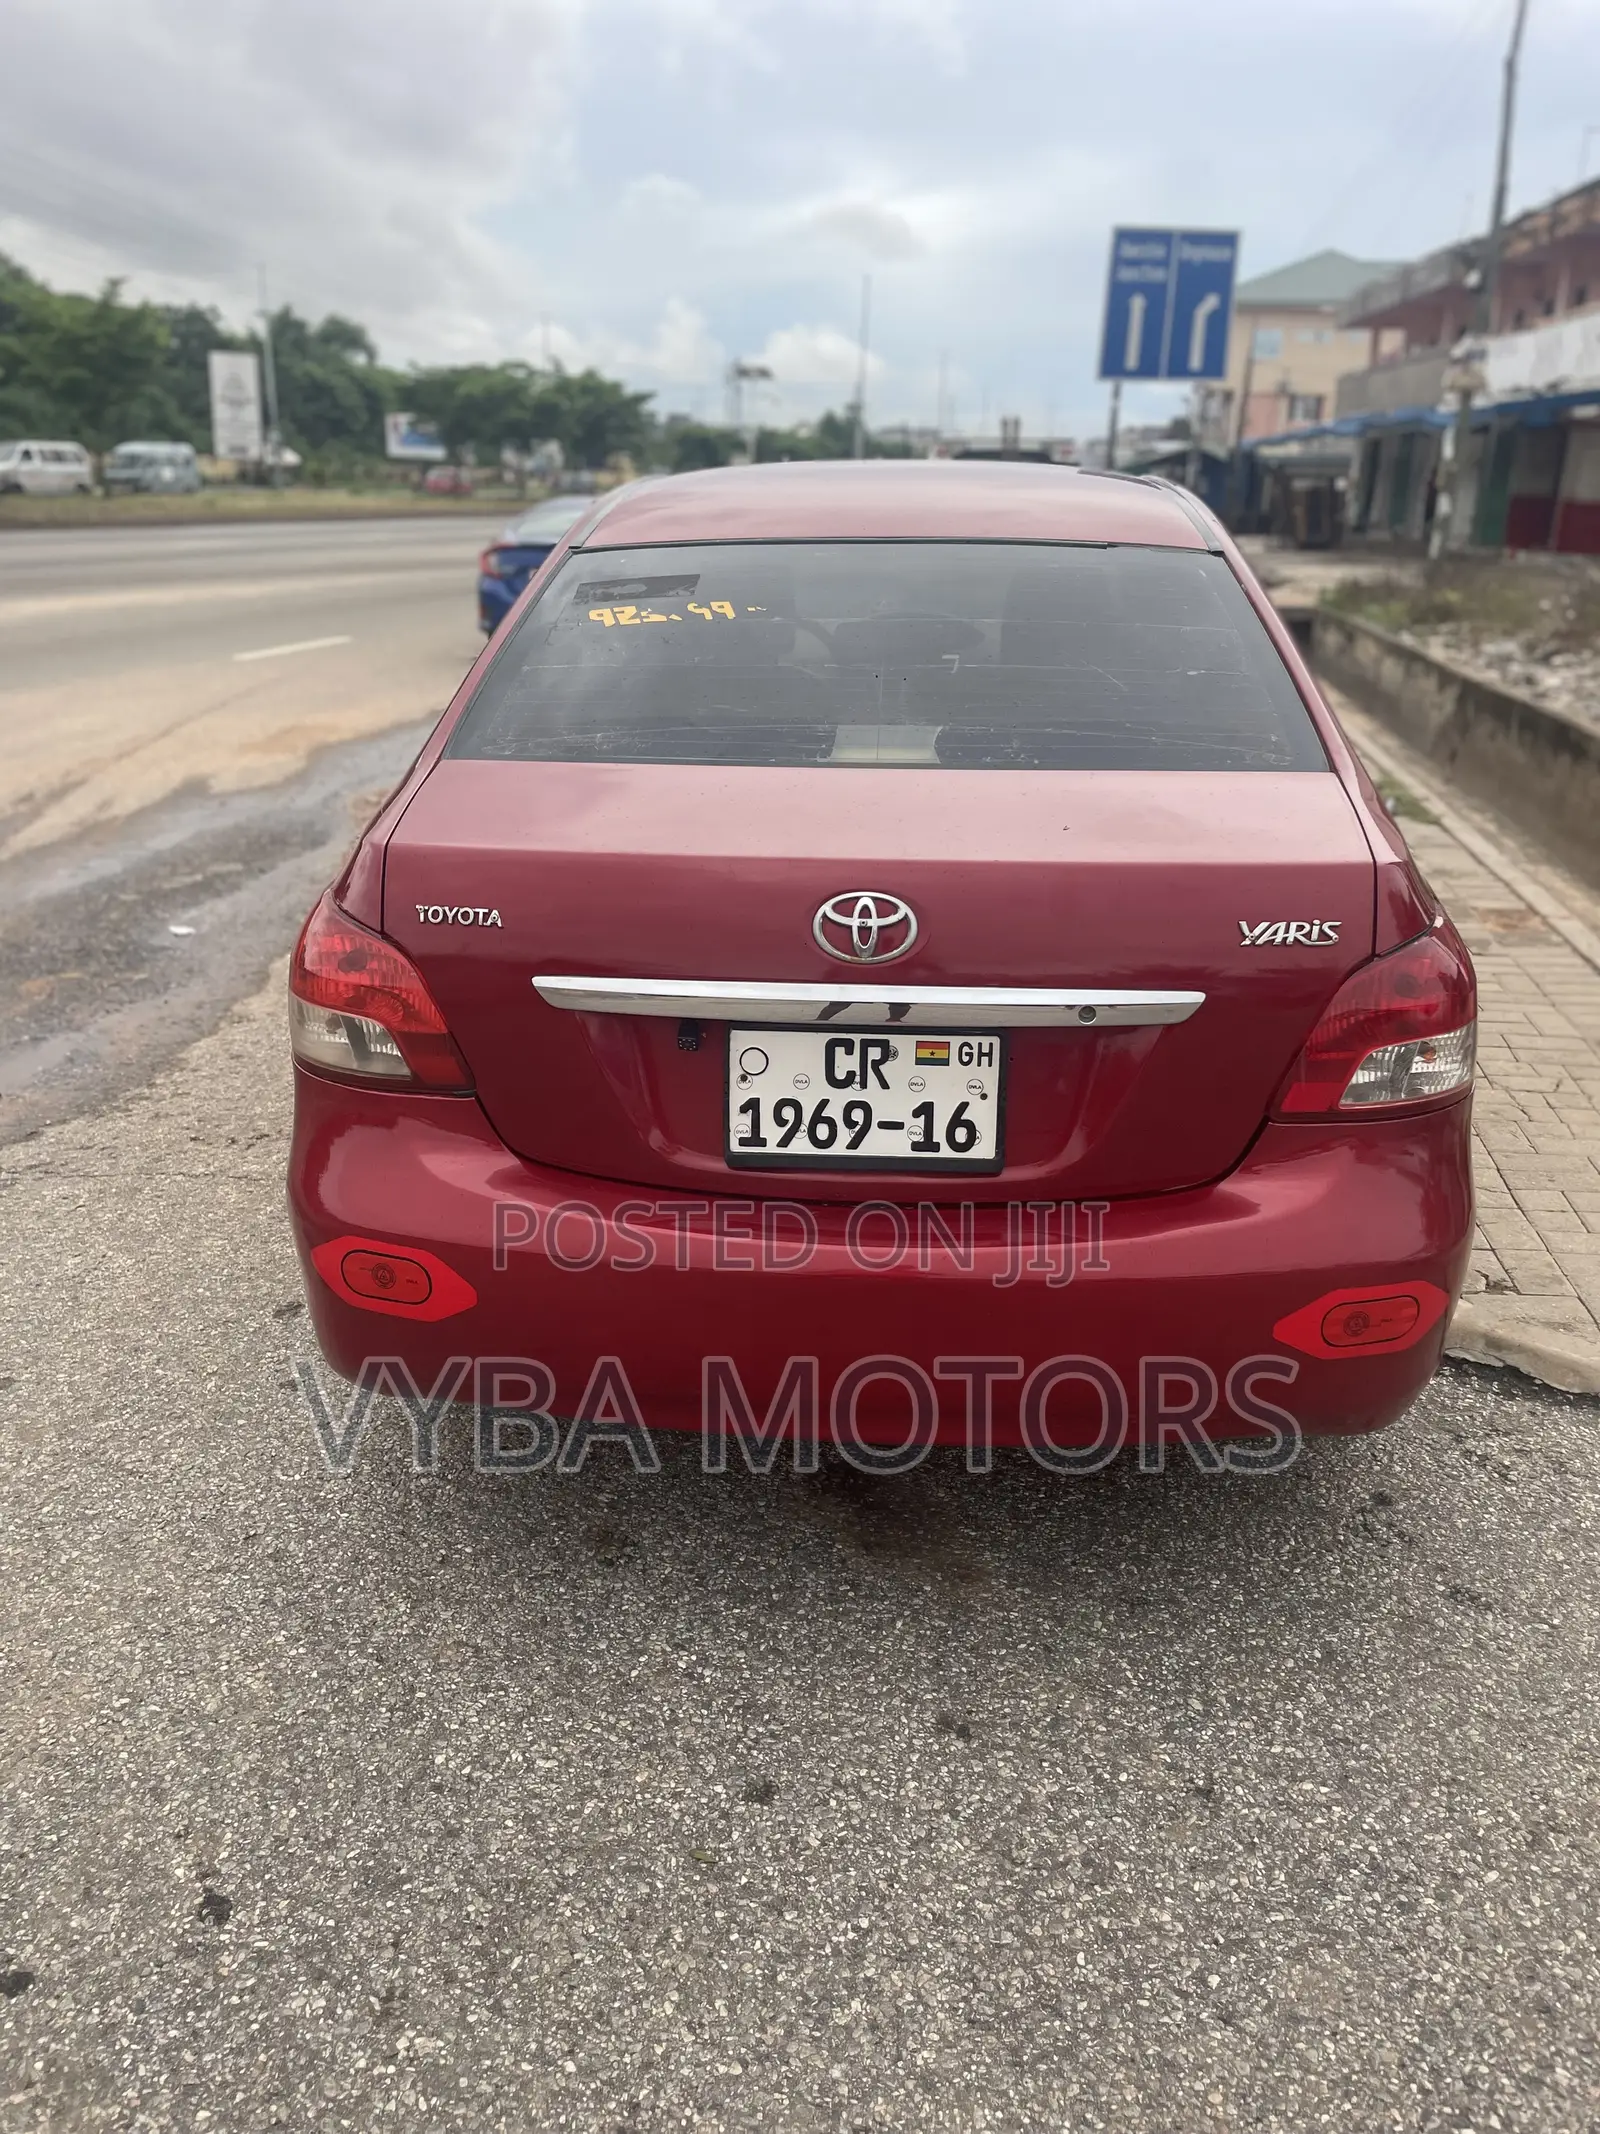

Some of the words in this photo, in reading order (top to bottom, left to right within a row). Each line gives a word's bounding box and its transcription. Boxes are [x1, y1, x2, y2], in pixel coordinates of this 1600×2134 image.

[415, 904, 502, 927] TOYOTA
[825, 1037, 890, 1090] CR
[957, 1041, 994, 1068] GH
[738, 1096, 977, 1154] 1969-16
